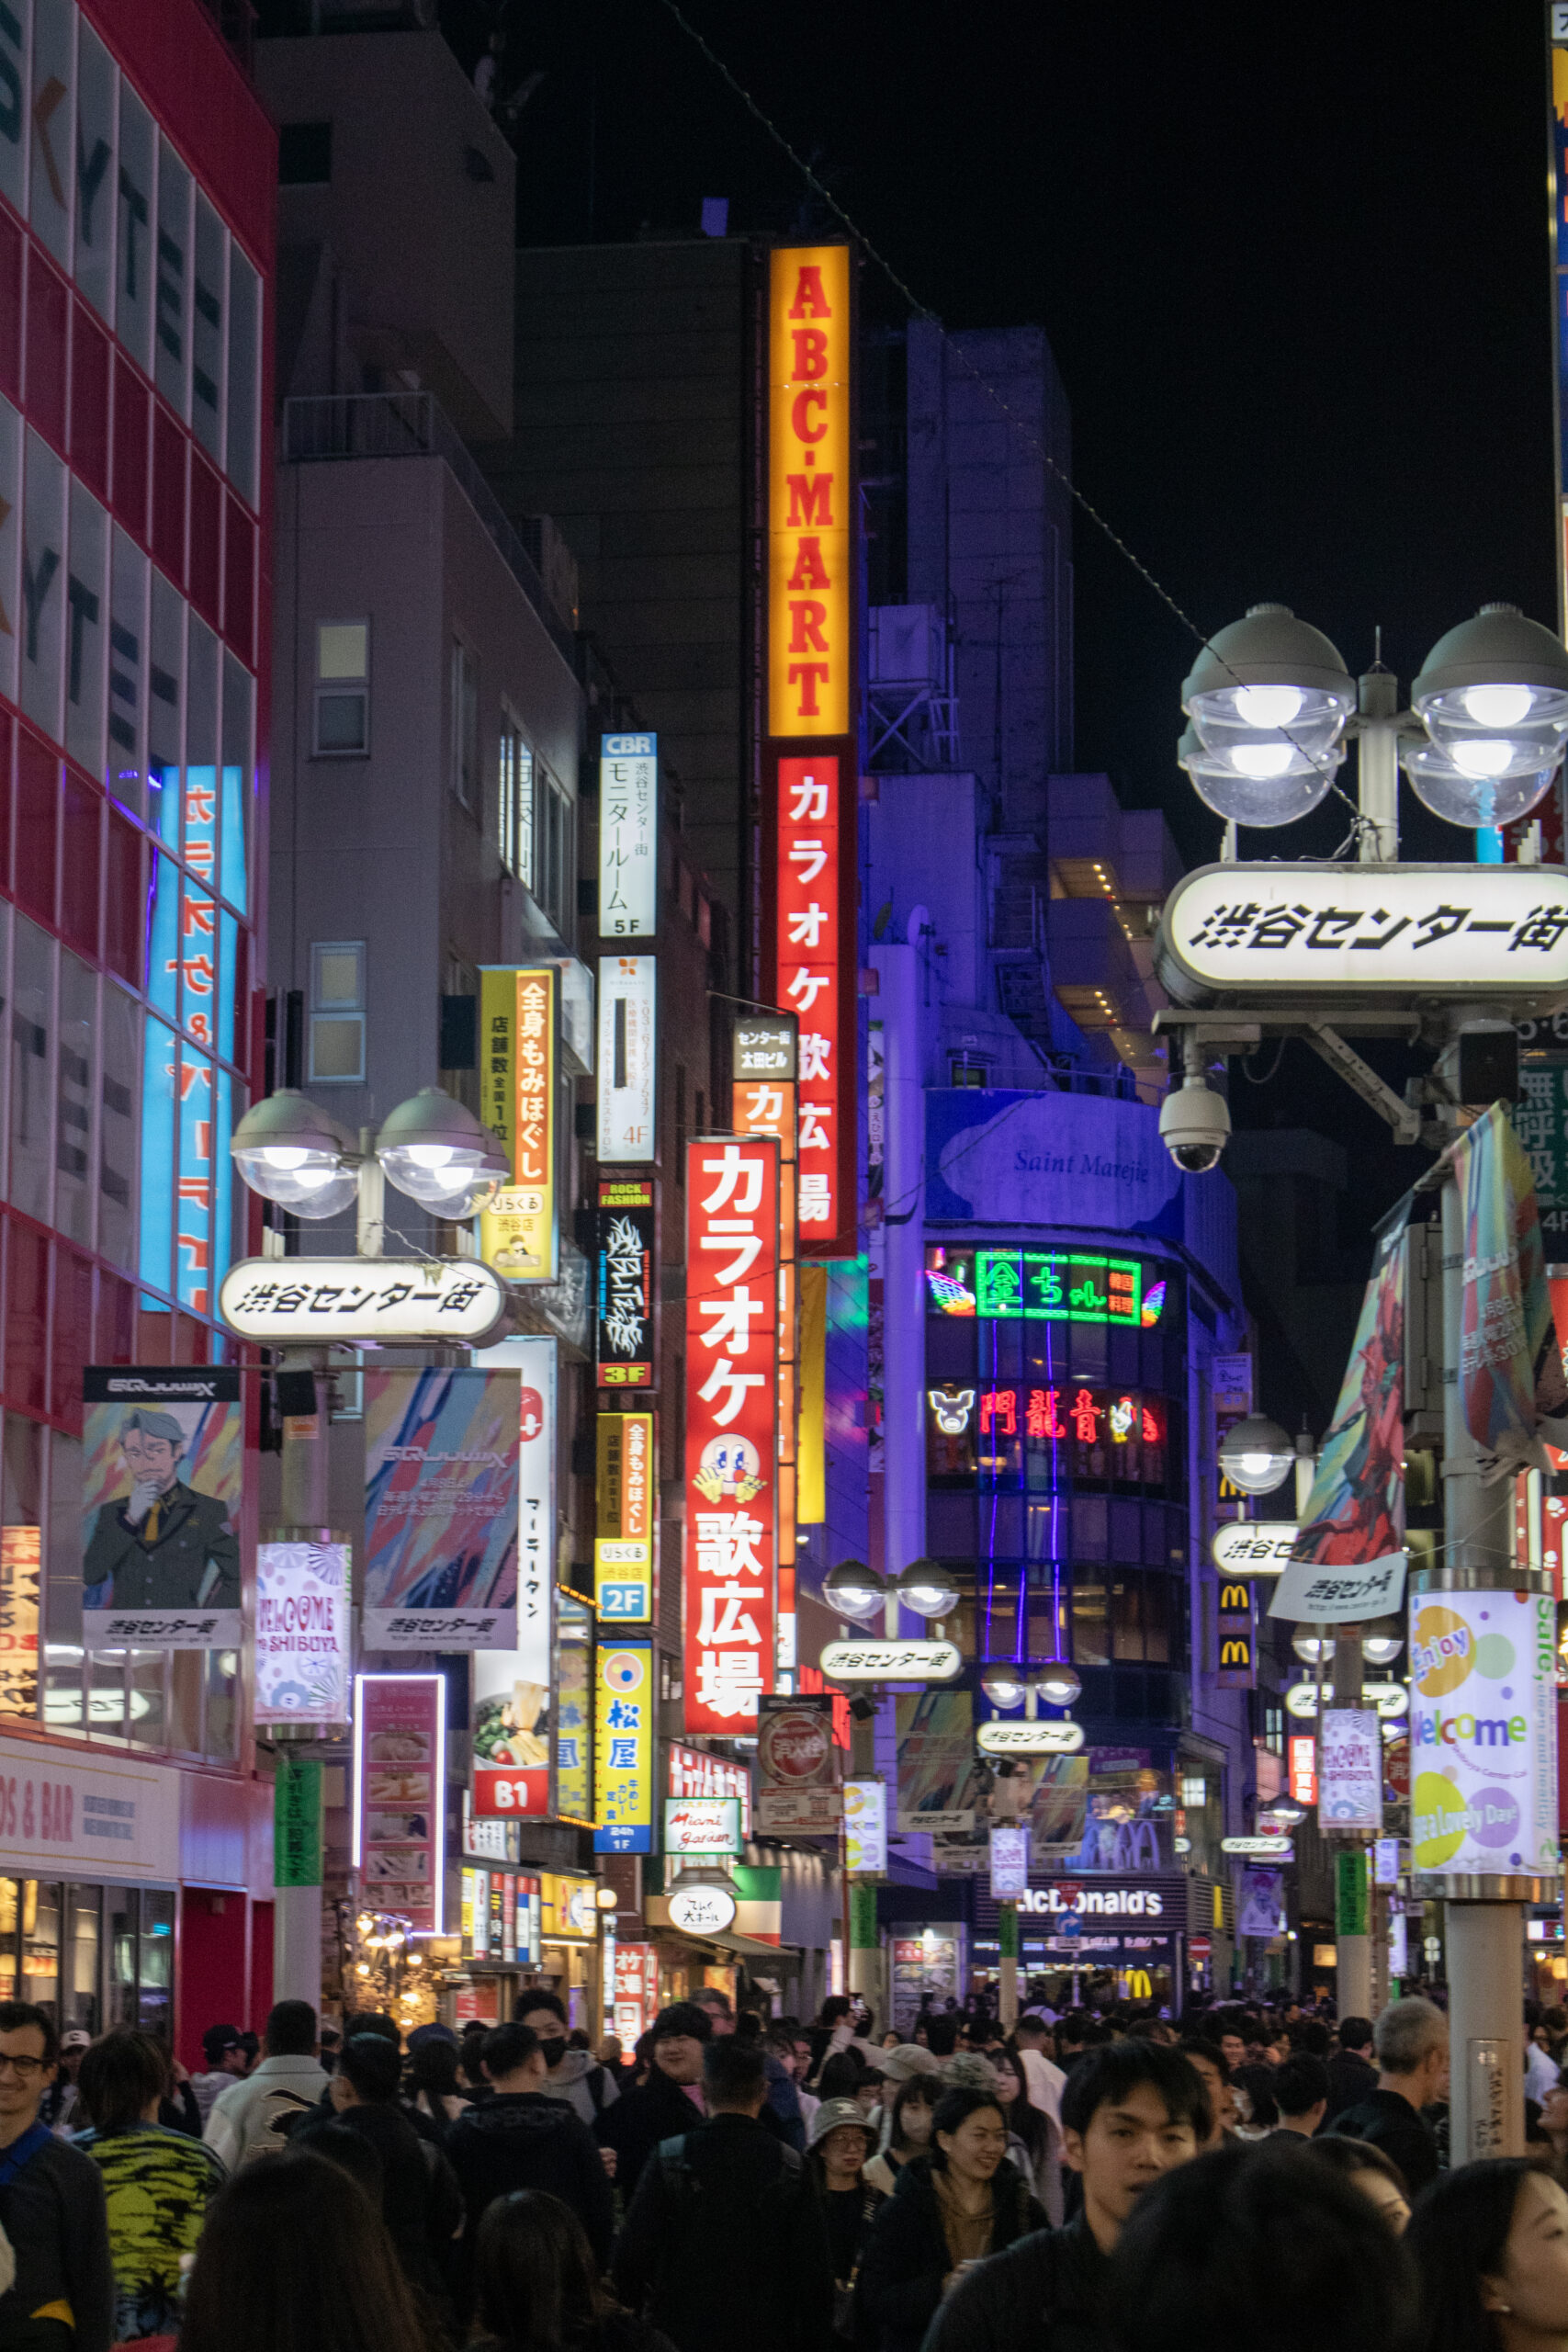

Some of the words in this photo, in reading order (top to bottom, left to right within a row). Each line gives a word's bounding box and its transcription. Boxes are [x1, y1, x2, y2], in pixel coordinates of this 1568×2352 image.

[606, 736, 650, 754] CBR
[635, 762, 649, 856] 渋谷センター街
[606, 763, 629, 910] モニタールーム
[615, 920, 640, 933] 5F
[1189, 902, 1568, 952] 渋谷センター街
[737, 1031, 792, 1046] センター街
[521, 982, 547, 1178] 全身もみほぐし
[623, 1125, 649, 1144] 4F
[1014, 1149, 1076, 1175] Saint
[609, 1183, 641, 1194] ROCK
[601, 1194, 650, 1205] FASHION
[498, 1217, 534, 1232] 渋谷店
[699, 1145, 765, 1426] カラオケ
[986, 1261, 1107, 1308] 金ちゃん
[234, 1282, 485, 1313] 渋谷センター街
[604, 1365, 646, 1384] 3F
[628, 1423, 646, 1533] 全身もみほぐし
[604, 1547, 642, 1558] りらくる
[605, 1589, 641, 1611] 2F
[695, 1510, 764, 1717] 歌広場
[269, 1635, 340, 1653] SHIBUYA
[828, 1650, 953, 1668] 渋谷センター街
[606, 1699, 640, 1768] 松屋
[984, 1730, 1077, 1743] 渋谷センター街
[494, 1780, 528, 1808] B1
[41, 1781, 73, 1842] BAR
[669, 1812, 723, 1826] Miami
[613, 1839, 630, 1849] 1F
